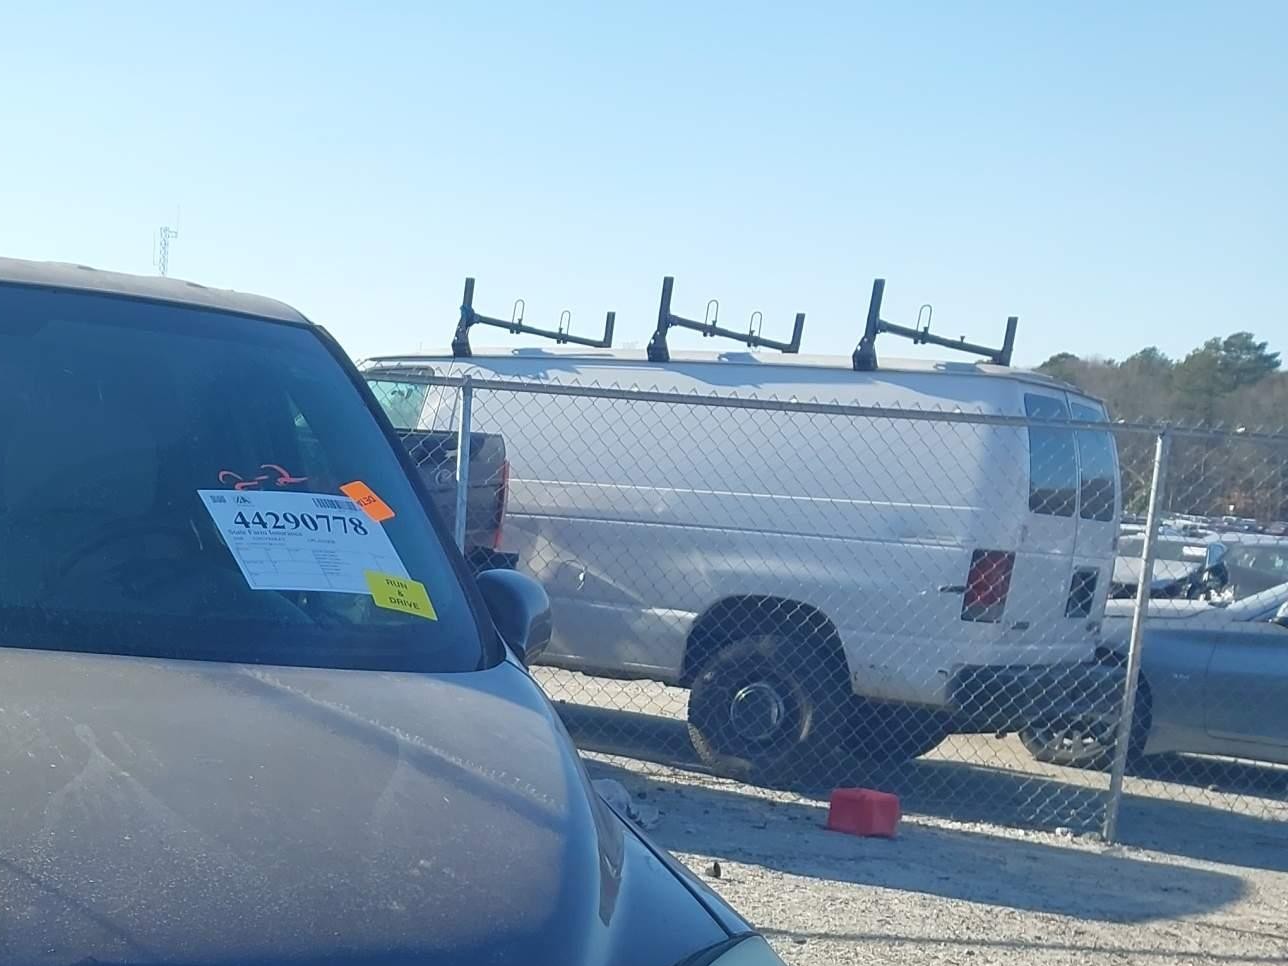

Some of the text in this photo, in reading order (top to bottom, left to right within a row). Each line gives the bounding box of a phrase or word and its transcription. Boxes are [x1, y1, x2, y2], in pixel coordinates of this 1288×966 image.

[233, 511, 368, 536] 44290778
[386, 578, 408, 590] RUN
[397, 590, 404, 598] &
[389, 597, 420, 610] DRIVE
